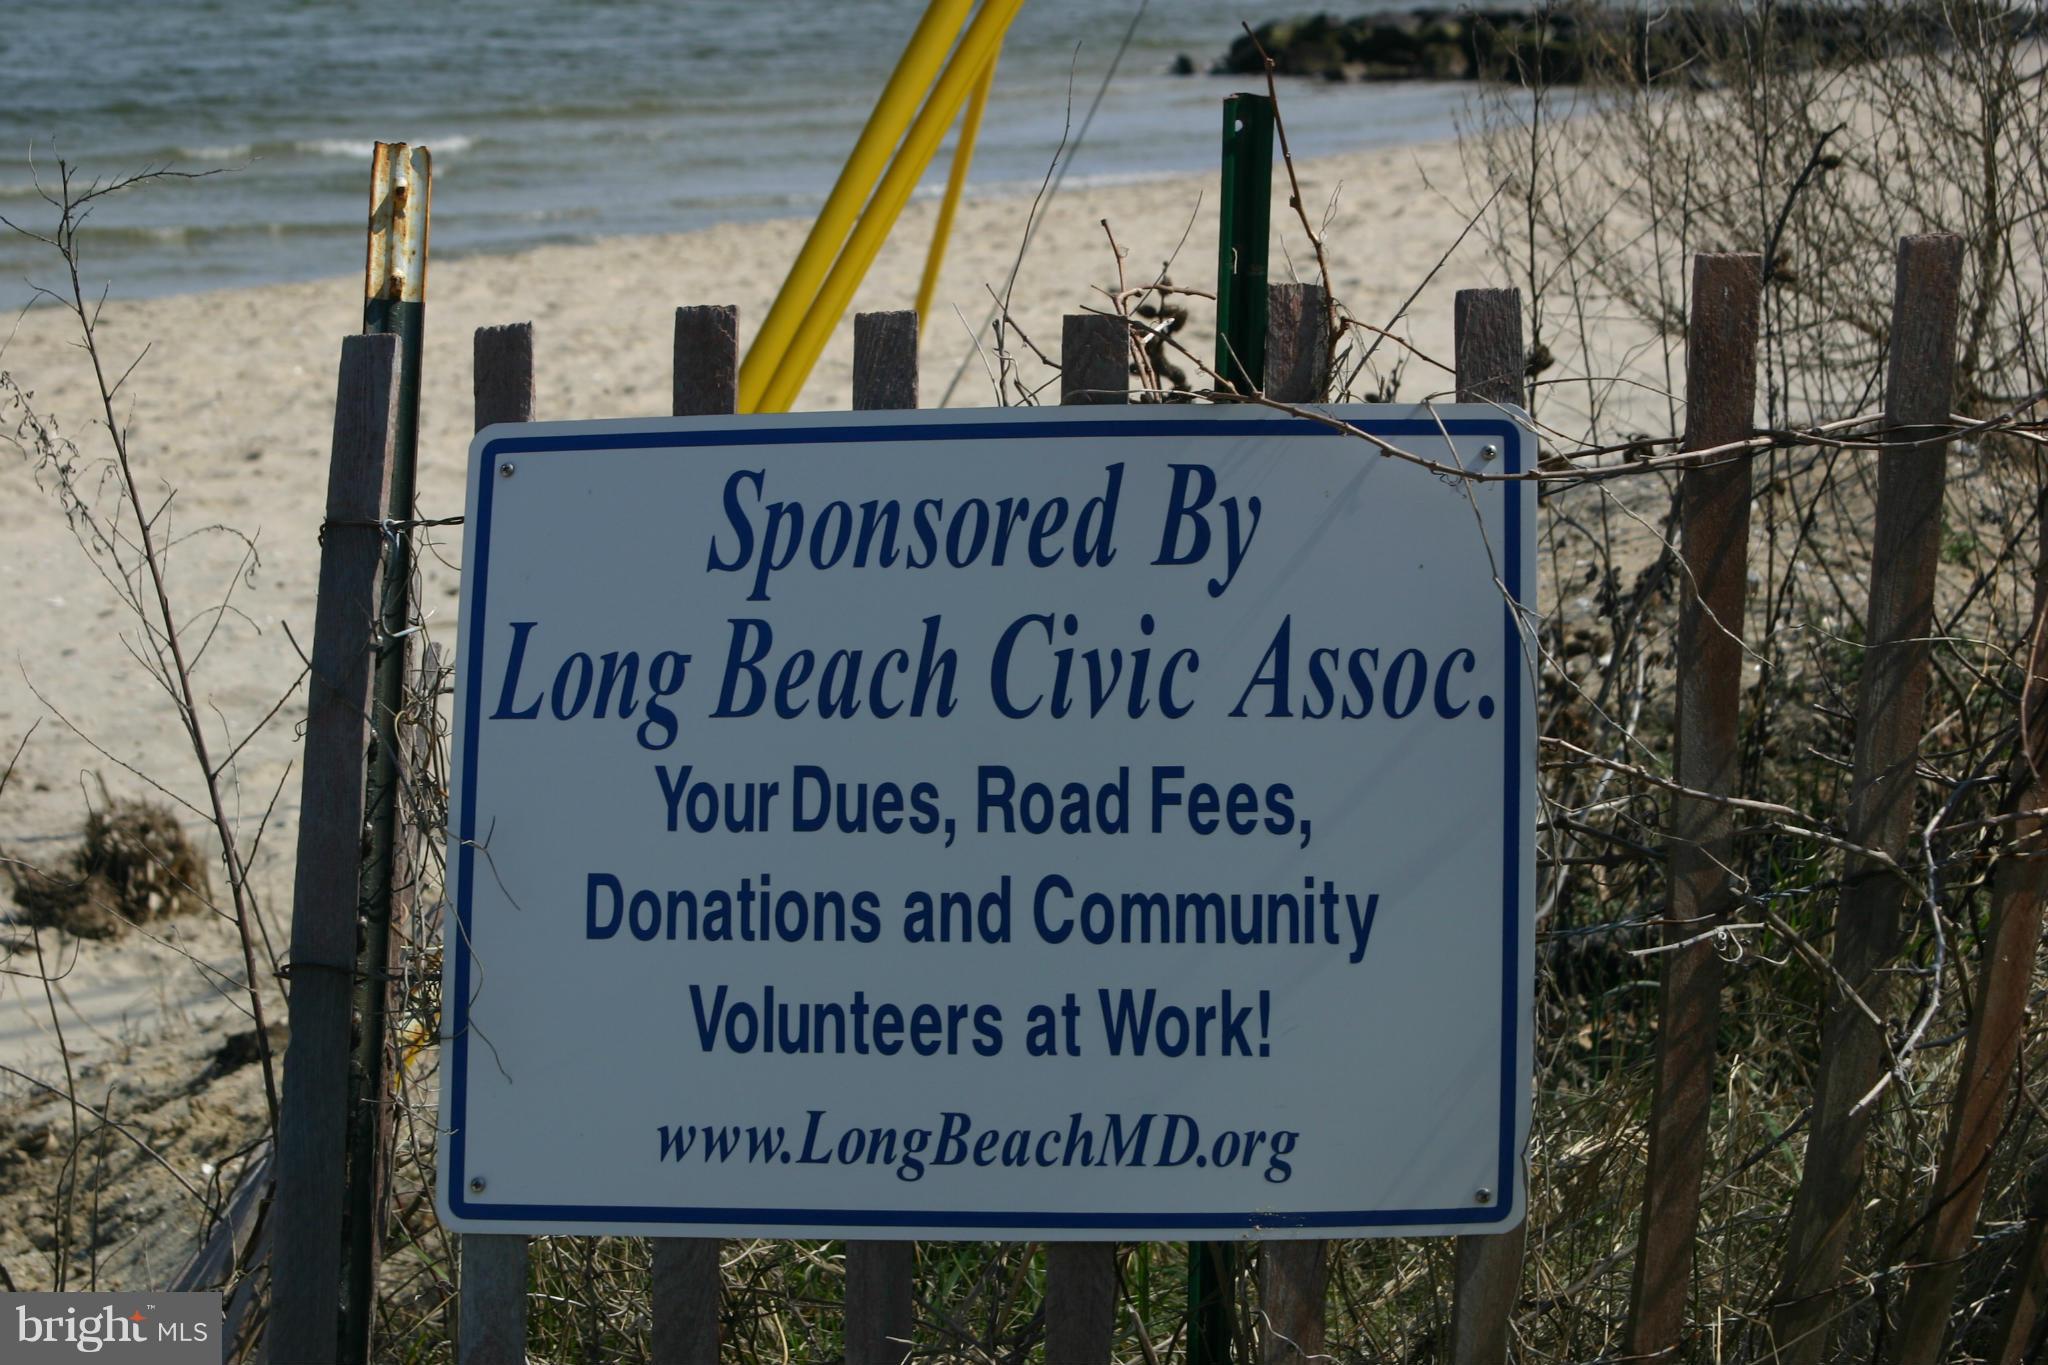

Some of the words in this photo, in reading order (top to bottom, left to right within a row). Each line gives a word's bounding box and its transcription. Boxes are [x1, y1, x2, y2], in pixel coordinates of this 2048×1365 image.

[706, 462, 1126, 601] Sponsored
[1150, 464, 1262, 599] By
[490, 621, 693, 750] Long
[708, 614, 959, 720] Beach
[991, 613, 1199, 720] Civic
[1228, 614, 1497, 720] Assoc.
[655, 765, 779, 833] Your
[792, 765, 955, 848] Dues,
[977, 765, 1129, 835] Road
[1152, 766, 1311, 849] Fees,
[586, 873, 881, 943] Donations
[904, 875, 1011, 944] and
[1033, 874, 1380, 964] Community
[689, 985, 1003, 1057] Volunteers
[1026, 993, 1081, 1057] at
[1098, 988, 1270, 1057] Work!
[657, 1110, 1300, 1184] www.LongBeachMD.org
